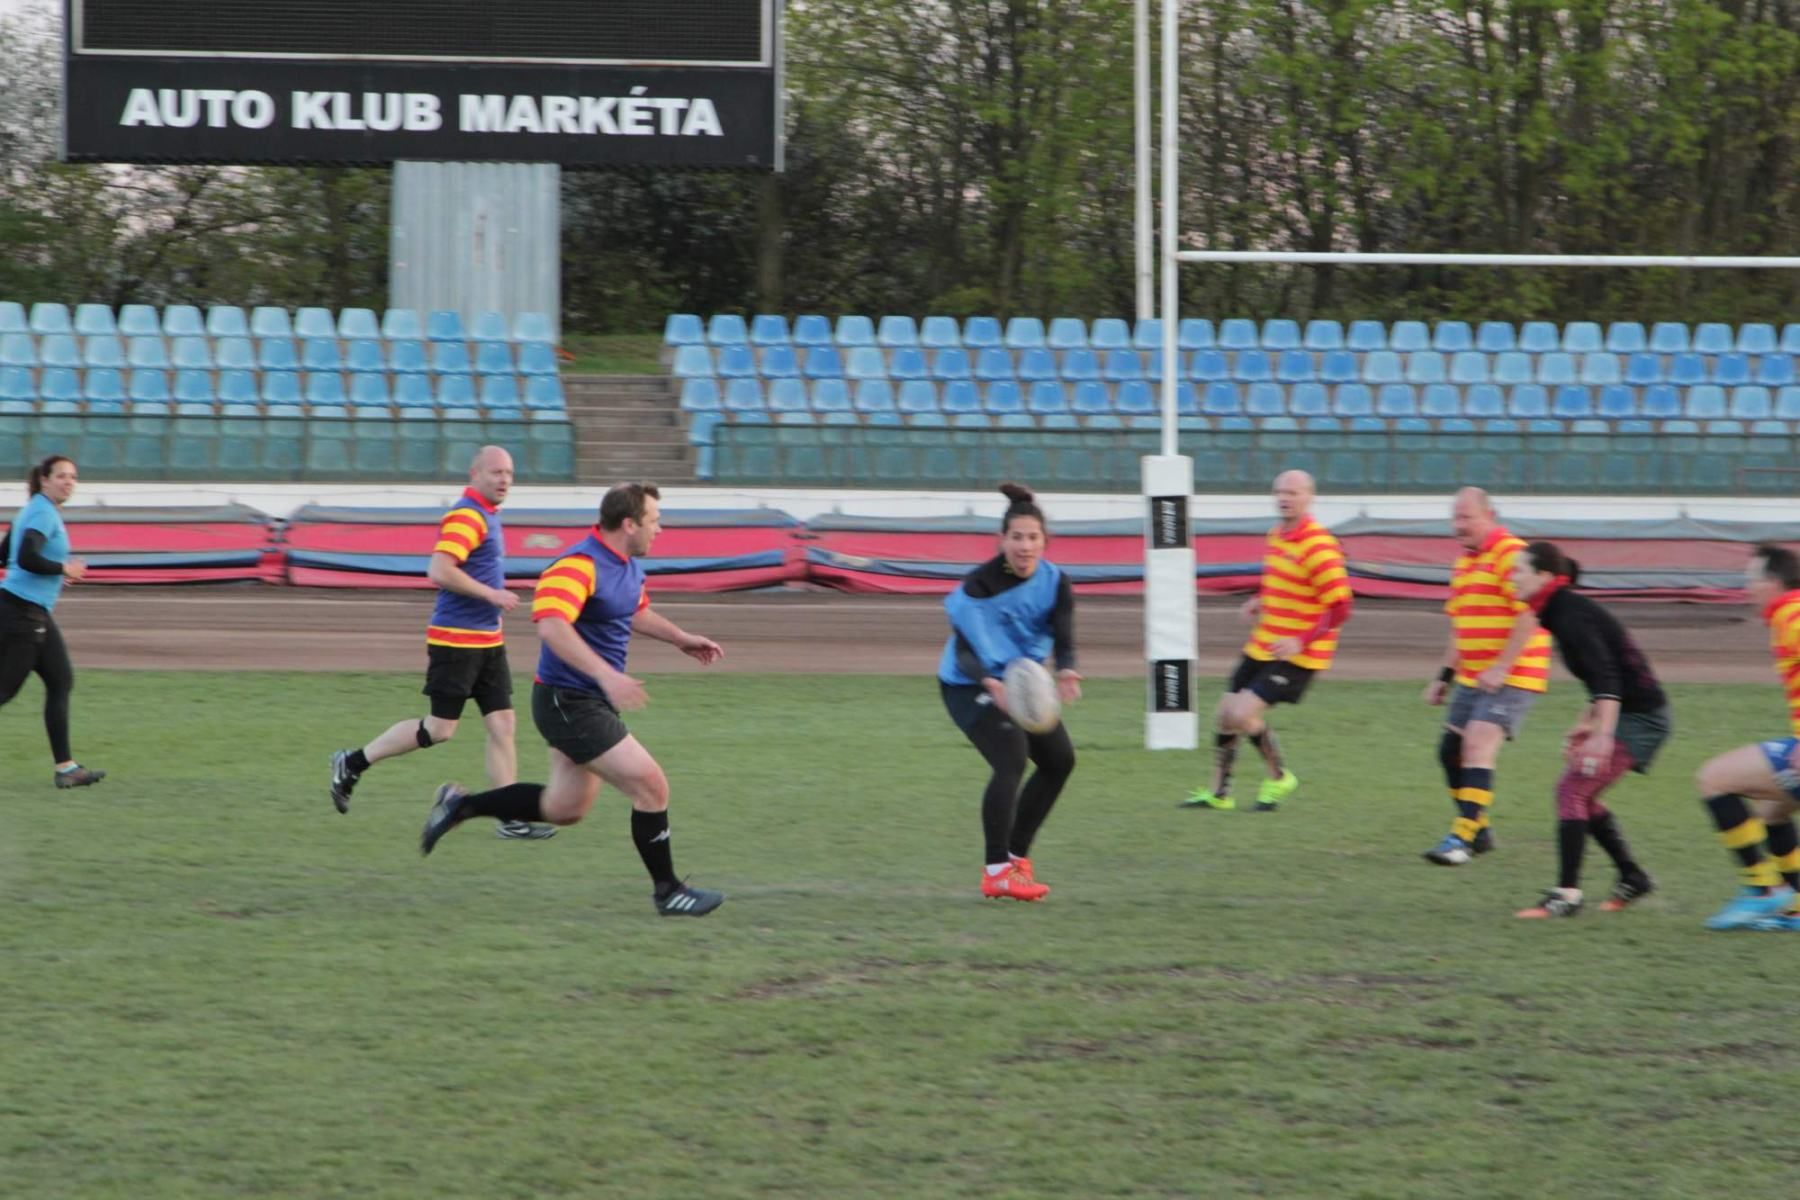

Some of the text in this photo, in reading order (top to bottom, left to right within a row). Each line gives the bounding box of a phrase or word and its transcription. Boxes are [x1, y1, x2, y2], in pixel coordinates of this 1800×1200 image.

[120, 87, 723, 136] AUTO KLUB MARKÉTA
